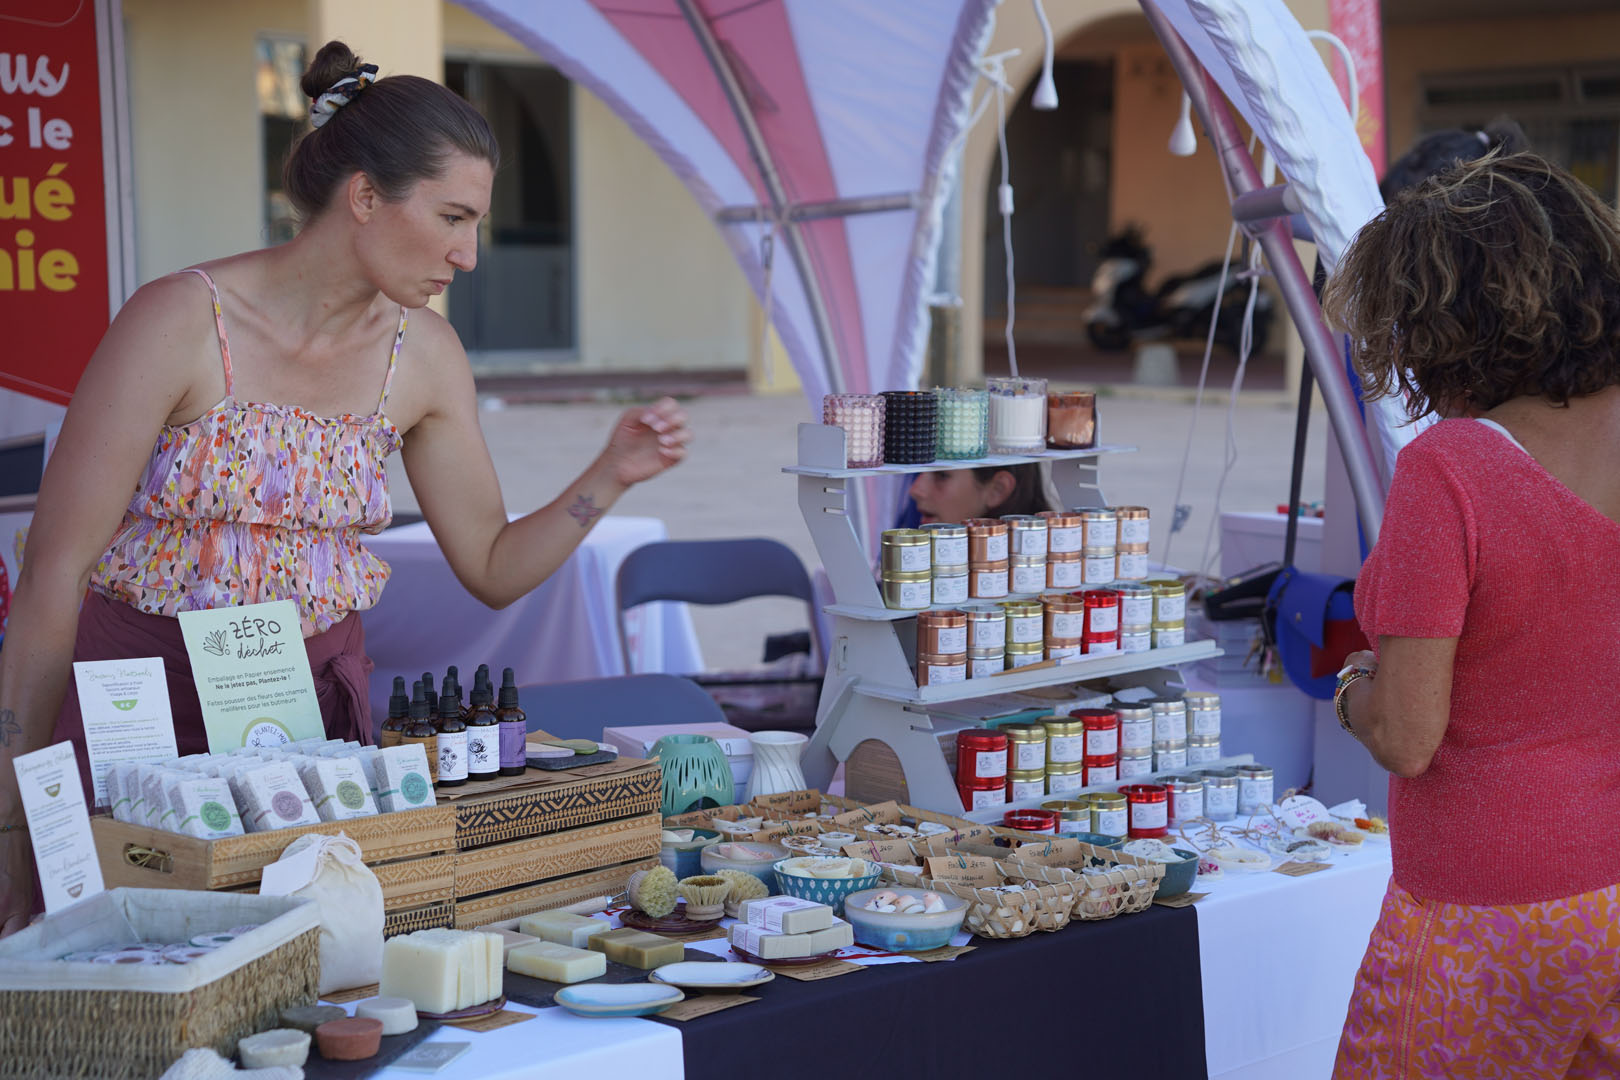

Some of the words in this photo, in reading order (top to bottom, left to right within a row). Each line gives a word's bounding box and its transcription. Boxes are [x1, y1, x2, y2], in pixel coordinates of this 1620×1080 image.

[27, 107, 73, 150] le
[229, 615, 281, 639] ZÉRO
[237, 637, 286, 659] déchet
[207, 673, 236, 683] Emballage
[245, 670, 262, 679] Papier
[263, 666, 296, 676] ensemencé
[230, 681, 244, 689] jetez
[245, 678, 258, 687] pas,
[258, 675, 287, 684] Plantez-le
[207, 699, 223, 707] Faites
[224, 696, 245, 706] pousser
[257, 692, 273, 700] fleurs
[285, 688, 308, 697] champs
[247, 702, 261, 710] pour
[270, 697, 297, 706] butineurs
